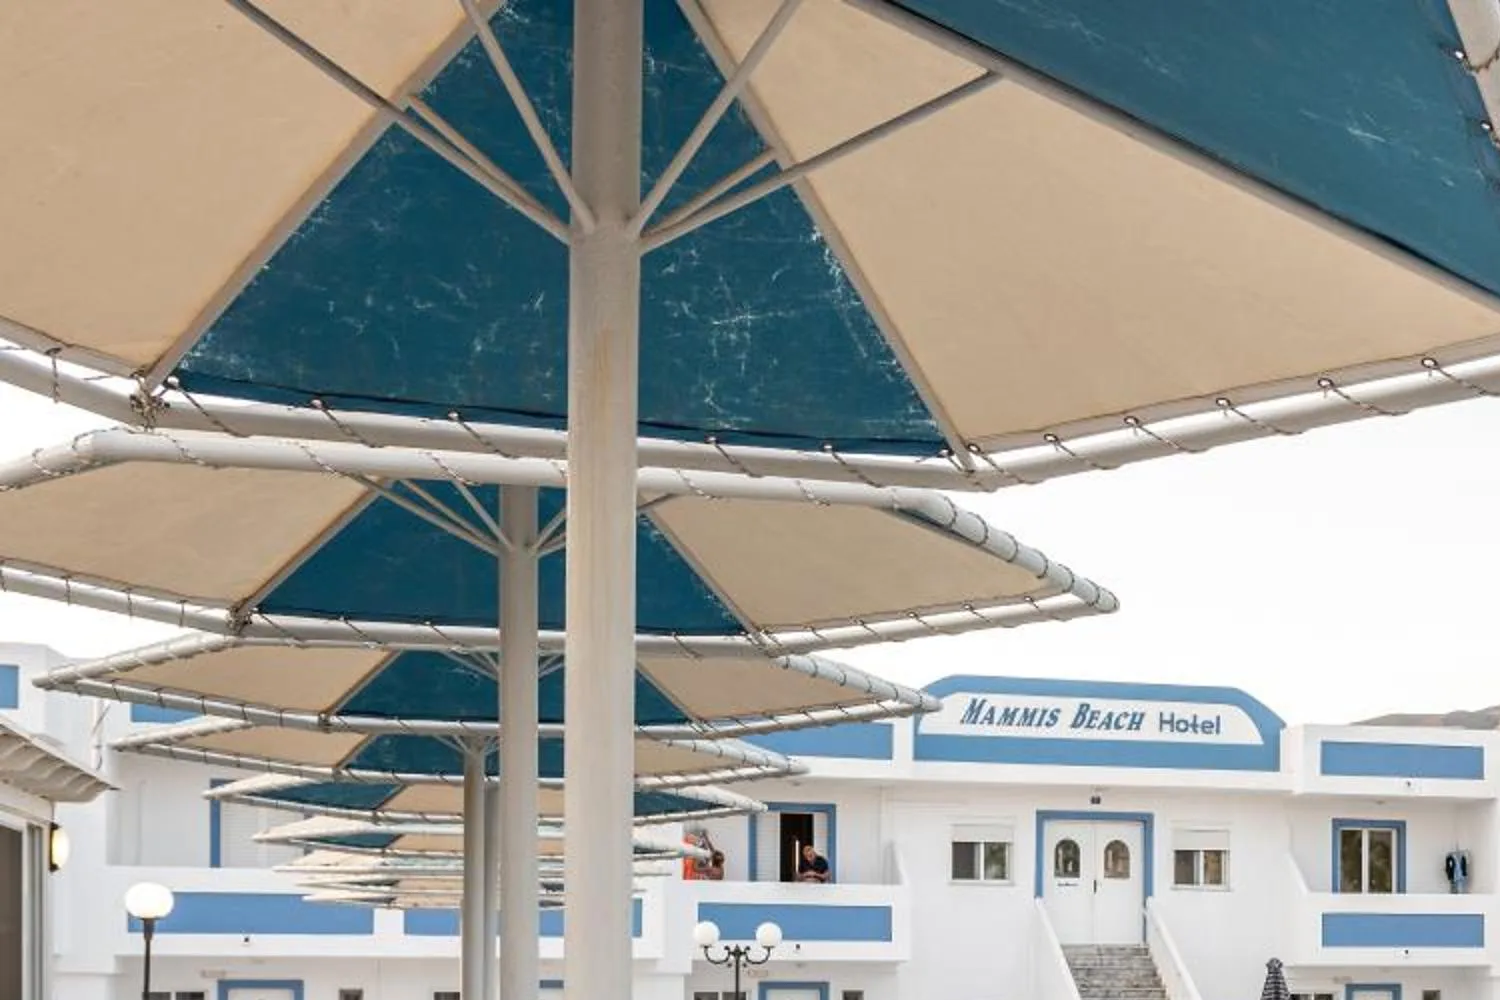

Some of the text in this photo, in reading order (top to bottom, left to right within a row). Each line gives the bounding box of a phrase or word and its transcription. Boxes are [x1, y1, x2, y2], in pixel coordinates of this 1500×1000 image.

[960, 698, 1221, 735] MAMMIS BEACH Hotel
